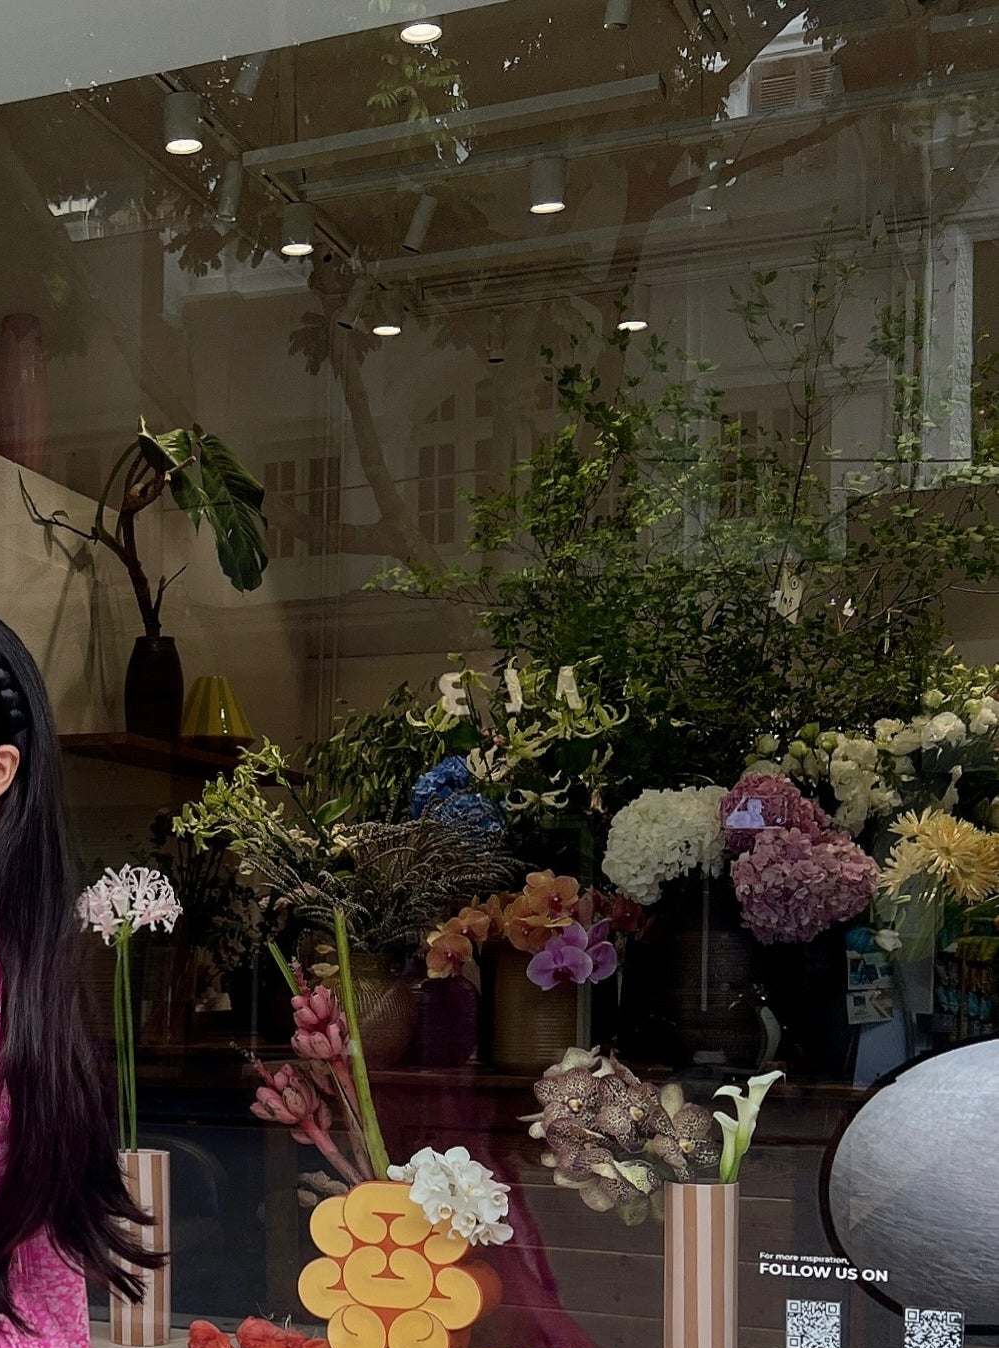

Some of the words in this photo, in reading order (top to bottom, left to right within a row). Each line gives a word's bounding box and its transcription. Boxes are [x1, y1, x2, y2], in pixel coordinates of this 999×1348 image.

[759, 1251, 773, 1260] For
[775, 1253, 799, 1262] more
[759, 1262, 832, 1279] FOLLOW
[835, 1266, 858, 1281] US
[861, 1269, 889, 1283] ON
